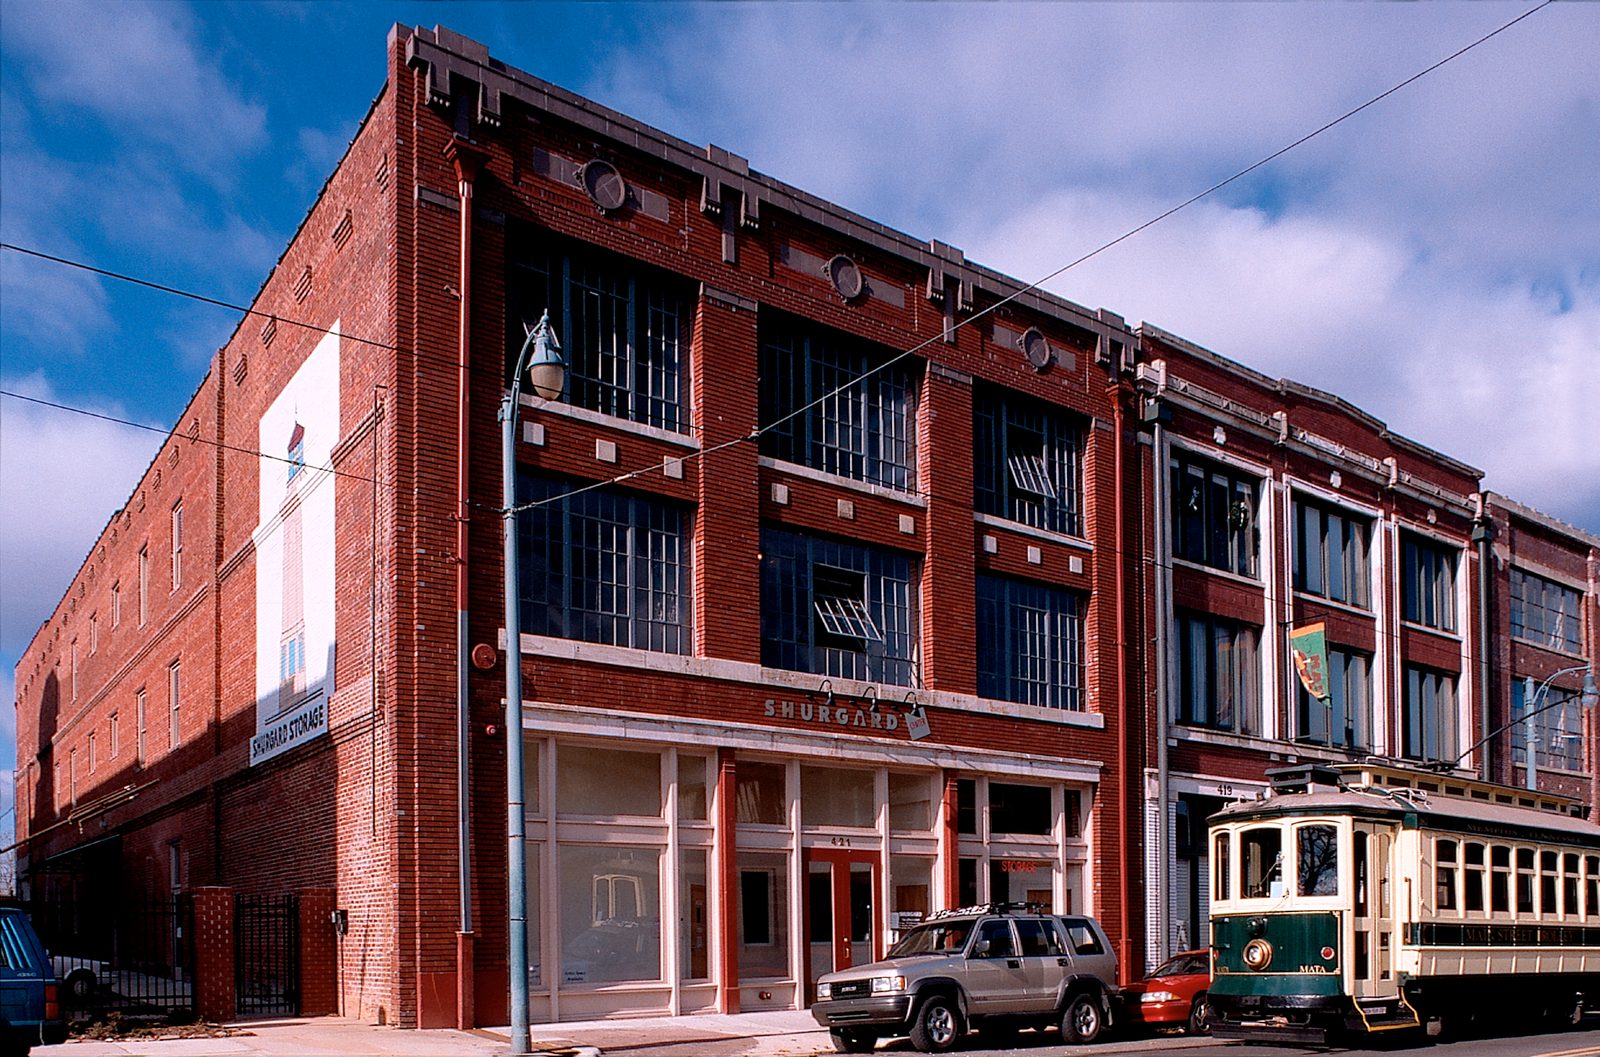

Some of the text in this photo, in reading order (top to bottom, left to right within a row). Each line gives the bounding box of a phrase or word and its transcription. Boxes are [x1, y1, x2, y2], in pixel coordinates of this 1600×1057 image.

[764, 699, 898, 730] SHURGARD
[289, 705, 323, 740] STORAGE
[1217, 784, 1233, 796] 419
[831, 837, 851, 847] 421
[1497, 928, 1533, 942] STREET
[1299, 965, 1326, 973] MATA
